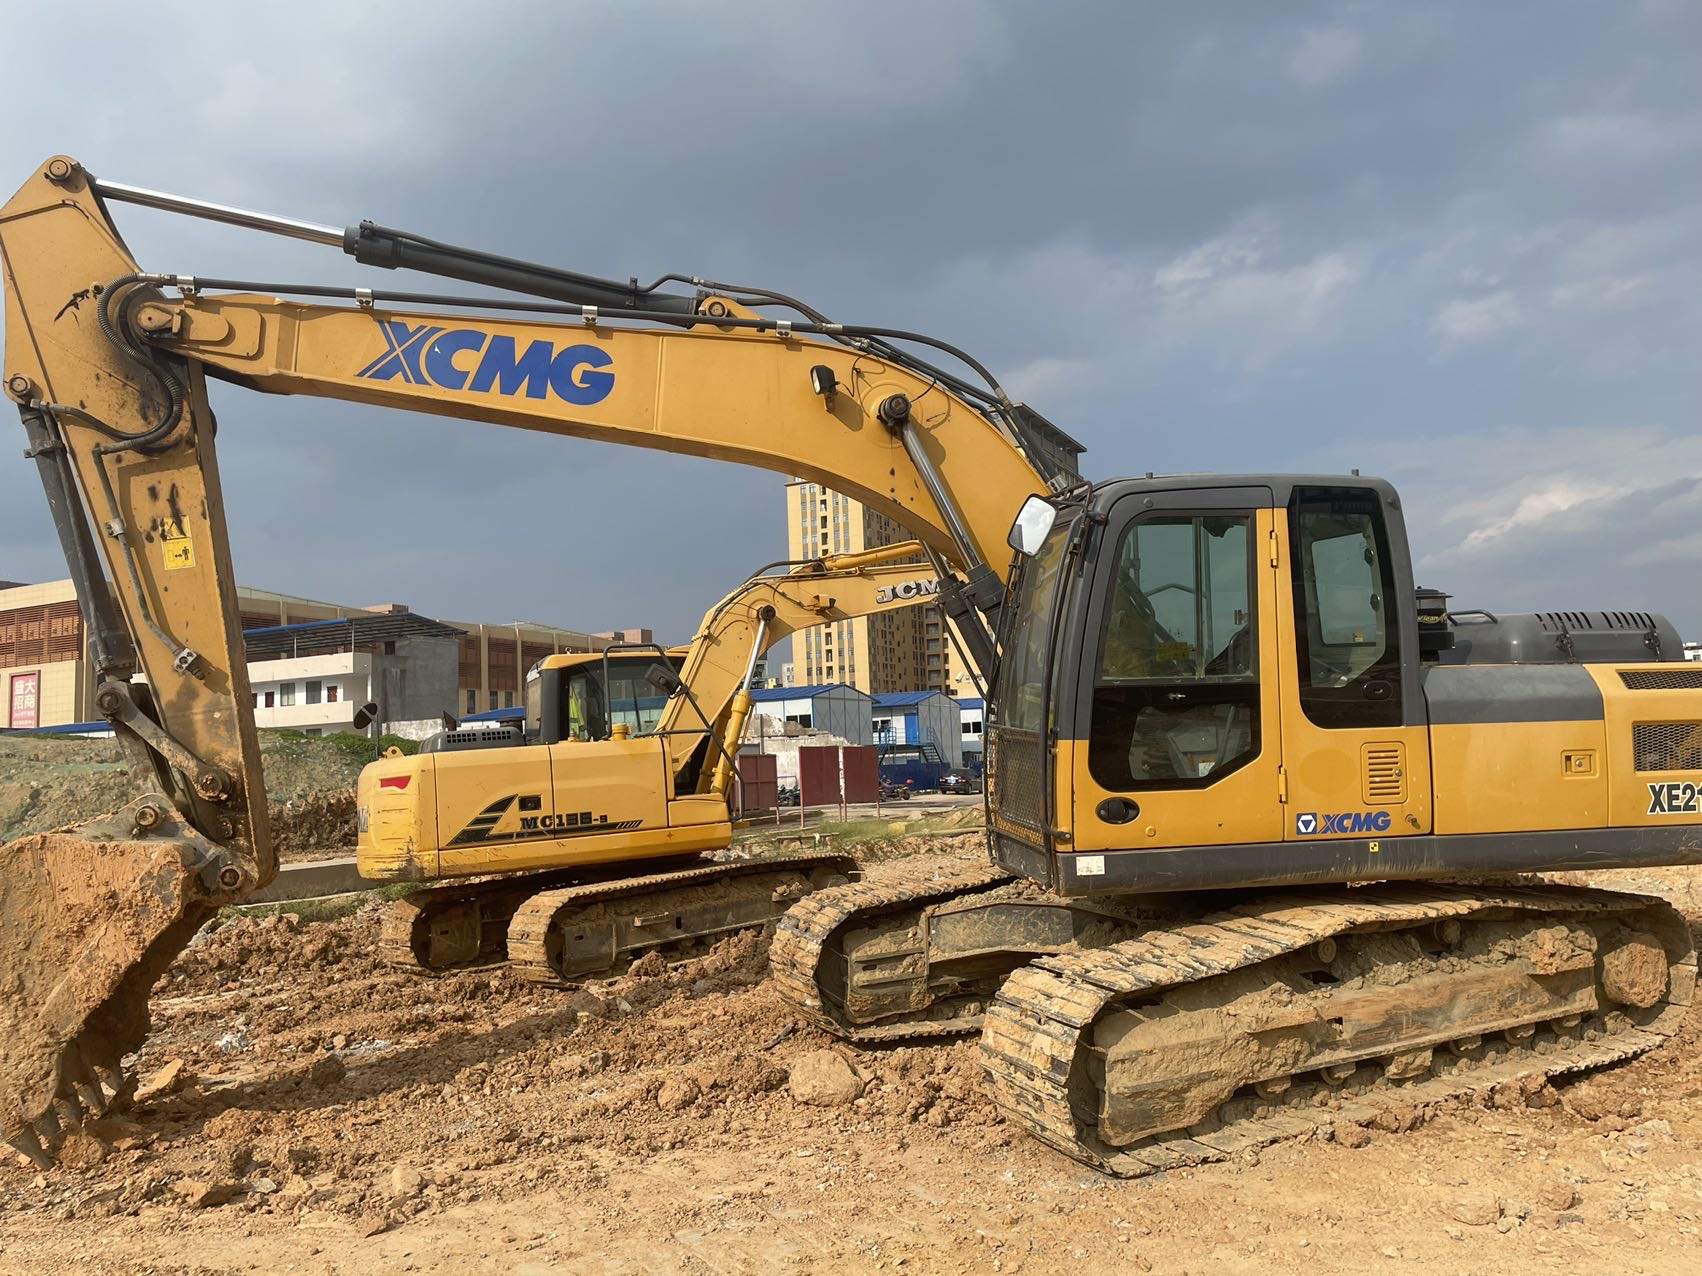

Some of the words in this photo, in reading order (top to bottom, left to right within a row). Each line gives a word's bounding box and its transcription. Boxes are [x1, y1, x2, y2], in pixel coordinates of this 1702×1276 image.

[353, 320, 615, 406] XCMG
[876, 578, 940, 604] JCM
[1317, 810, 1392, 834] XCMG
